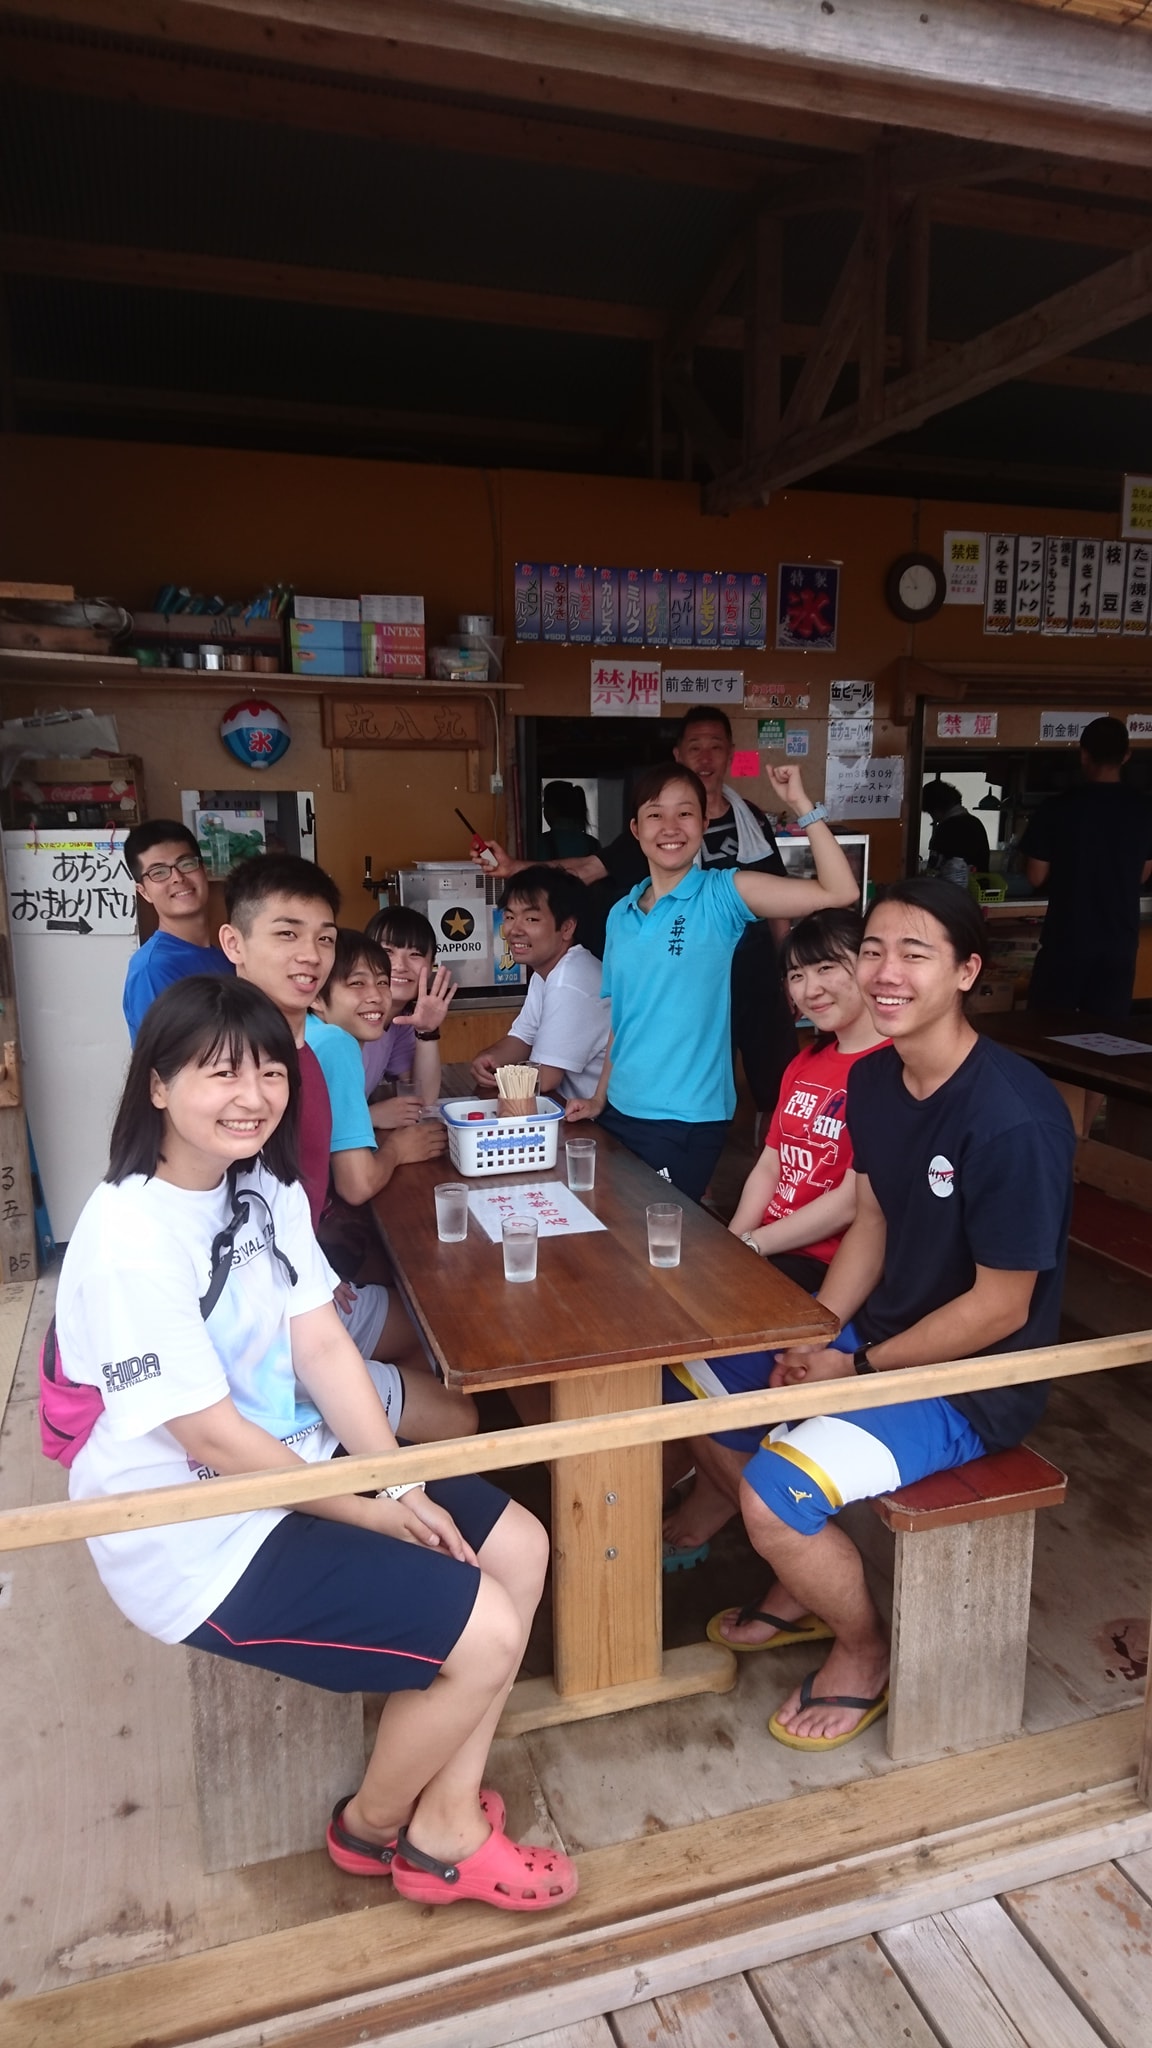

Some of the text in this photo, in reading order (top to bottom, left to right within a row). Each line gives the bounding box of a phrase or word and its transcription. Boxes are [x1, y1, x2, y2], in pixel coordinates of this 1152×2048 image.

[951, 544, 979, 560] 禁煙
[1060, 542, 1072, 567] 焼き
[994, 541, 1008, 614] みそ田楽
[1018, 560, 1030, 611] フルト
[1029, 541, 1042, 611] フランク
[1046, 541, 1058, 617] とうもろこし
[1079, 544, 1095, 616] 焼きイカ
[1103, 545, 1122, 613] 枝豆
[1130, 548, 1148, 614] たこ焼き
[516, 589, 528, 629] ミルク
[527, 580, 538, 616] メロン
[543, 590, 556, 630] ミルク
[569, 591, 581, 631] ミルク
[626, 585, 640, 634] ミルク
[700, 586, 717, 636] レモン
[724, 588, 738, 636] いちご
[748, 590, 763, 637] メロン
[787, 588, 833, 638] 氷
[383, 626, 420, 637] INTEX
[384, 654, 421, 665] INTEX
[593, 668, 659, 704] 禁煙
[665, 676, 738, 693] 前金制です
[249, 731, 273, 753] 氷
[943, 714, 993, 736] 禁煙
[1042, 723, 1085, 738] 前金制
[836, 782, 892, 791] オーダーストッ
[52, 852, 133, 883] あちらへ
[11, 887, 136, 921] おまわり下さい
[436, 942, 482, 953] SAPPORO
[784, 1101, 814, 1120] 11.29
[790, 1090, 818, 1108] 2015
[9, 1252, 32, 1277] B5
